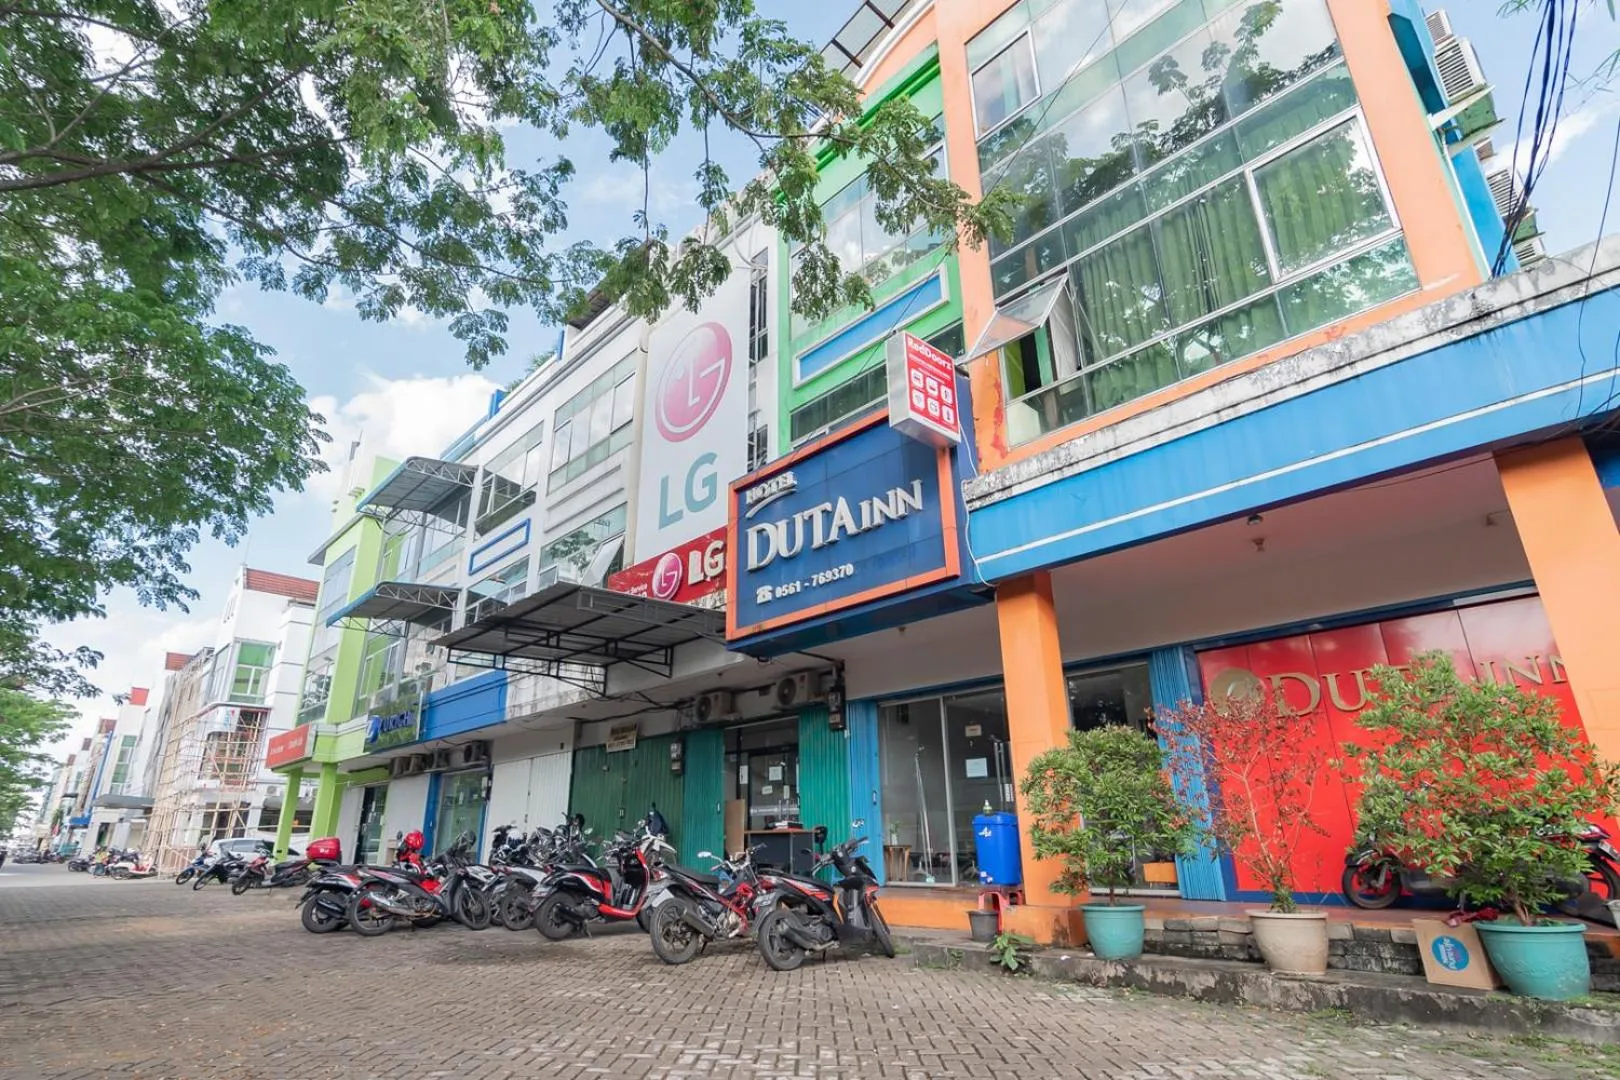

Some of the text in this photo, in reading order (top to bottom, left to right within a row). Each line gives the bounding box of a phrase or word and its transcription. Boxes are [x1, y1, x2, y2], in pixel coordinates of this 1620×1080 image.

[907, 336, 953, 369] RedDoorz
[658, 451, 719, 530] LG
[745, 470, 798, 505] HOTEL
[745, 479, 923, 572] DUTA INN
[687, 540, 725, 586] LG
[811, 562, 855, 587] 769370
